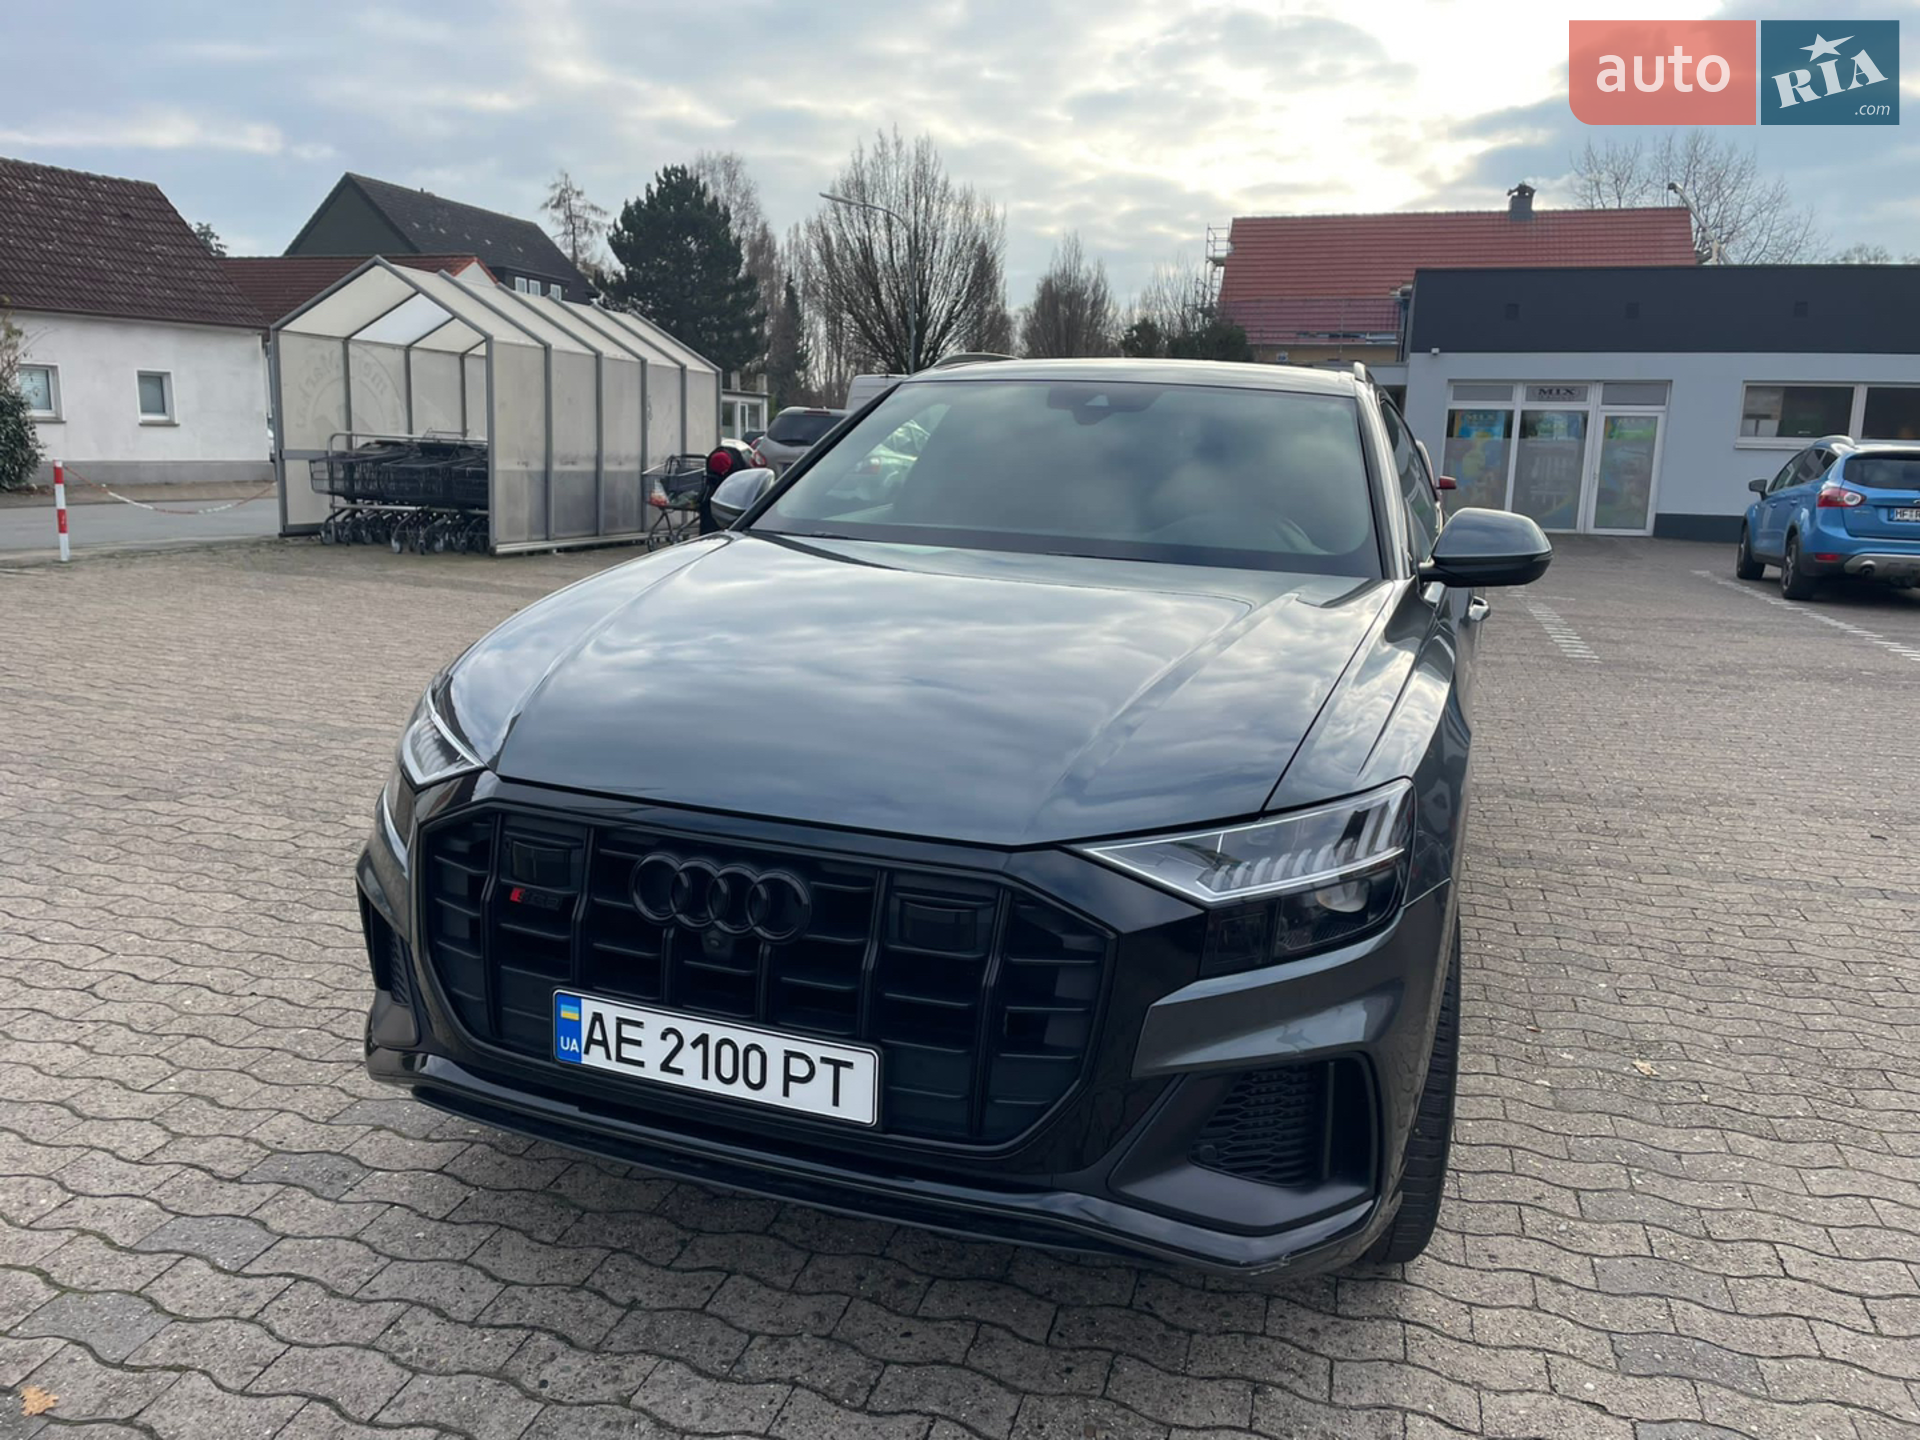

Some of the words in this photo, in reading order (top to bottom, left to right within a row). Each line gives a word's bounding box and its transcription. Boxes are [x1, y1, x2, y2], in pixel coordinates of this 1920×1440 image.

[1538, 388, 1576, 396] MIX
[560, 1036, 580, 1053] UA
[584, 1012, 645, 1068] AE
[659, 1027, 768, 1091] 2100
[782, 1049, 854, 1108] PT
